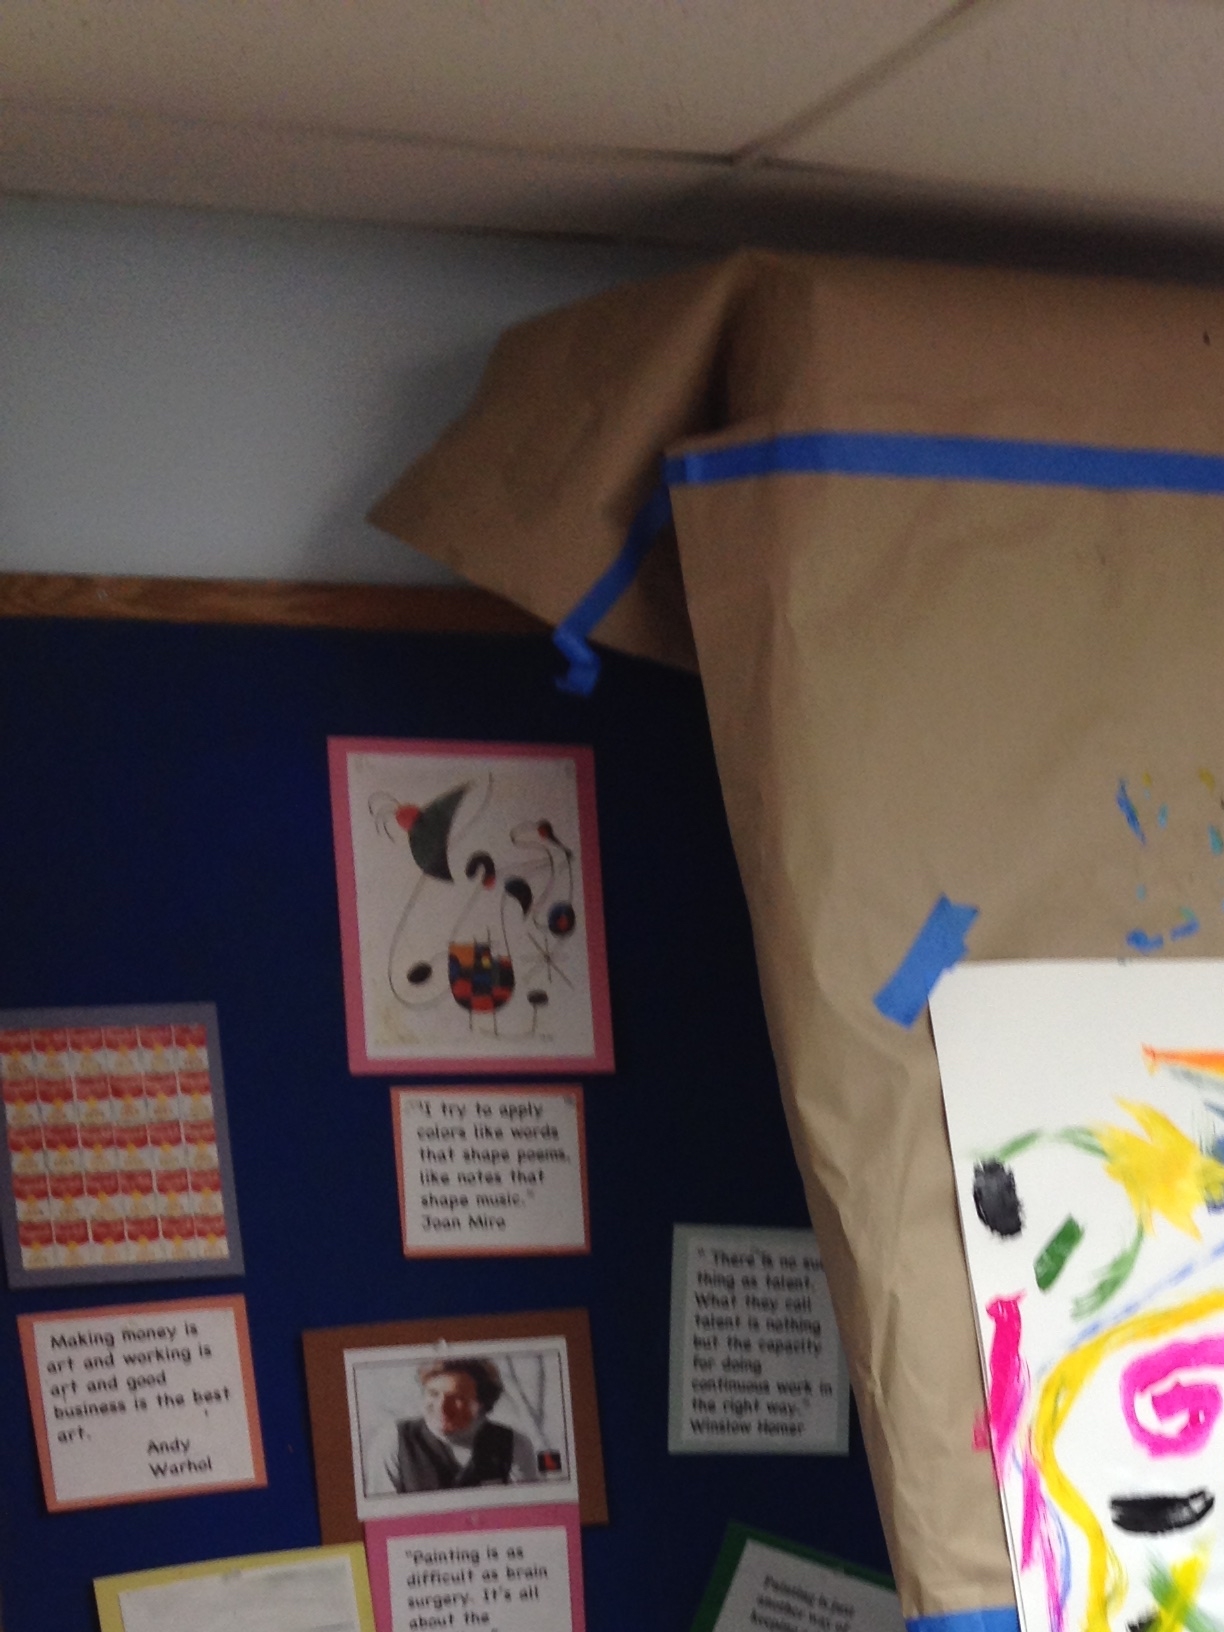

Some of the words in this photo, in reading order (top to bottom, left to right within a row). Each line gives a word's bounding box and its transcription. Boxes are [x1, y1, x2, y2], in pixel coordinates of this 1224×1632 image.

[441, 1102, 466, 1118] try
[476, 1101, 492, 1117] to
[499, 1102, 544, 1121] apply
[417, 1125, 466, 1141] colors
[473, 1123, 504, 1140] like
[510, 1123, 560, 1141] words
[420, 1148, 455, 1163] that
[463, 1147, 510, 1165] shape
[420, 1169, 450, 1185] like
[457, 1168, 502, 1184] notes
[510, 1169, 544, 1185] that
[421, 1192, 469, 1211] shape
[422, 1214, 461, 1232] Joan
[50, 1329, 115, 1350] Making
[122, 1324, 177, 1343] money
[185, 1320, 199, 1336] is
[47, 1356, 75, 1374] art
[84, 1352, 115, 1371] and
[122, 1346, 192, 1366] working
[198, 1343, 212, 1358] is
[51, 1379, 77, 1397] art
[87, 1375, 118, 1393] and
[126, 1370, 167, 1392] good
[53, 1400, 127, 1420] business
[134, 1396, 147, 1411] is
[157, 1391, 185, 1408] the
[192, 1385, 231, 1406] best
[147, 1436, 191, 1456] Andy
[149, 1456, 213, 1479] Warhol
[486, 1544, 499, 1559] is
[506, 1545, 524, 1560] as
[406, 1568, 474, 1588] difficult
[482, 1571, 499, 1583] as
[506, 1565, 548, 1581] brain
[483, 1586, 512, 1602] It's
[519, 1584, 539, 1600] all
[409, 1613, 454, 1631] about
[464, 1610, 490, 1625] the
